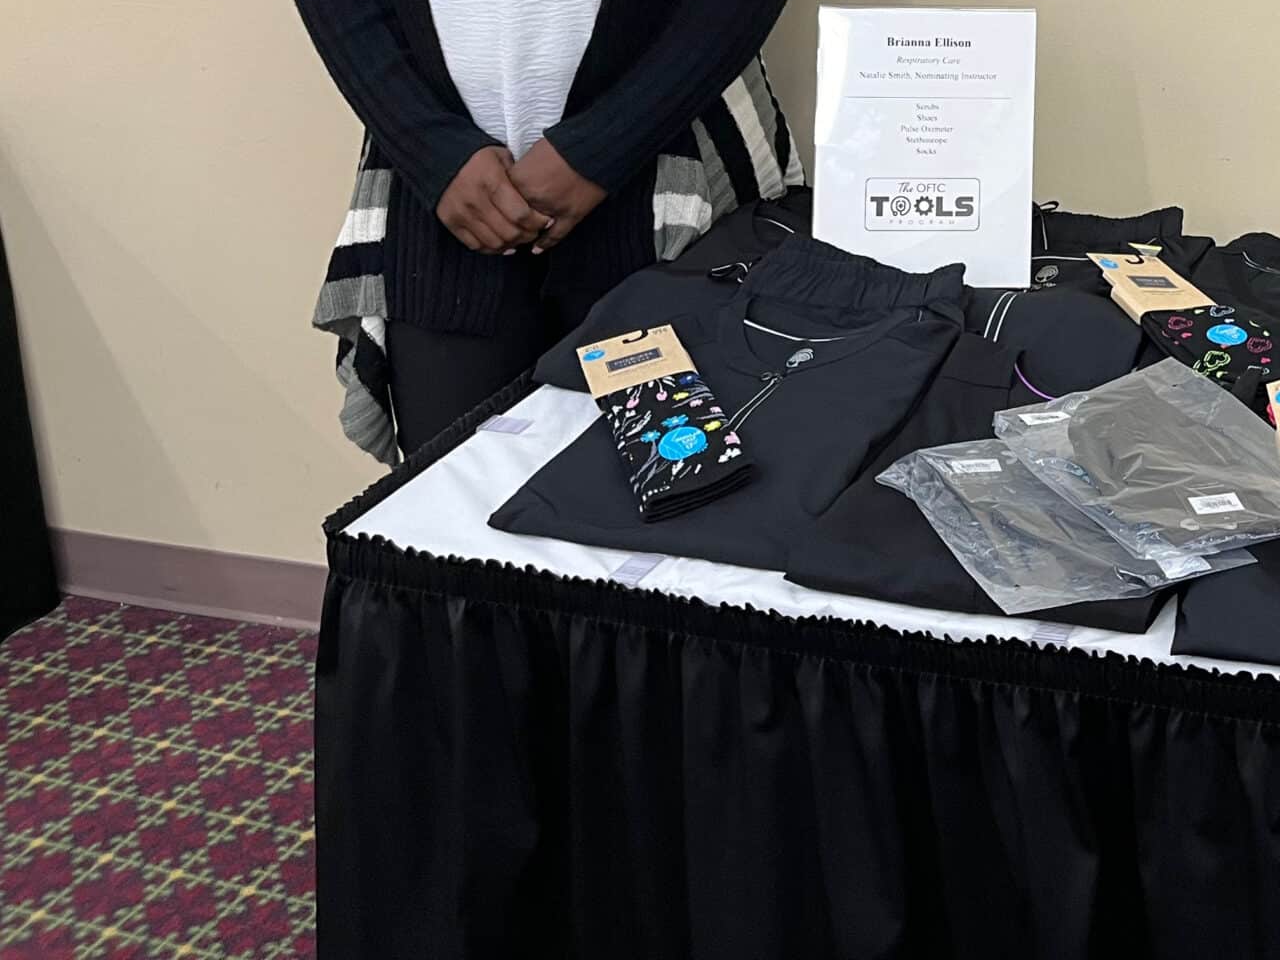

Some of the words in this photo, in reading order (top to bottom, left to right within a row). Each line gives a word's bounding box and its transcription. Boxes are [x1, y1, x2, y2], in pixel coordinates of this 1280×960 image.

[887, 36, 931, 48] Brianna
[935, 37, 972, 48] Ellison
[896, 56, 940, 65] Respiratory
[942, 56, 961, 64] Care
[859, 71, 886, 80] Natalie
[888, 72, 913, 80] Smith,
[914, 72, 959, 81] Nominating
[961, 72, 997, 81] Instructor
[898, 182, 914, 193] The
[916, 183, 946, 193] OFTC
[870, 195, 974, 217] TOOLS
